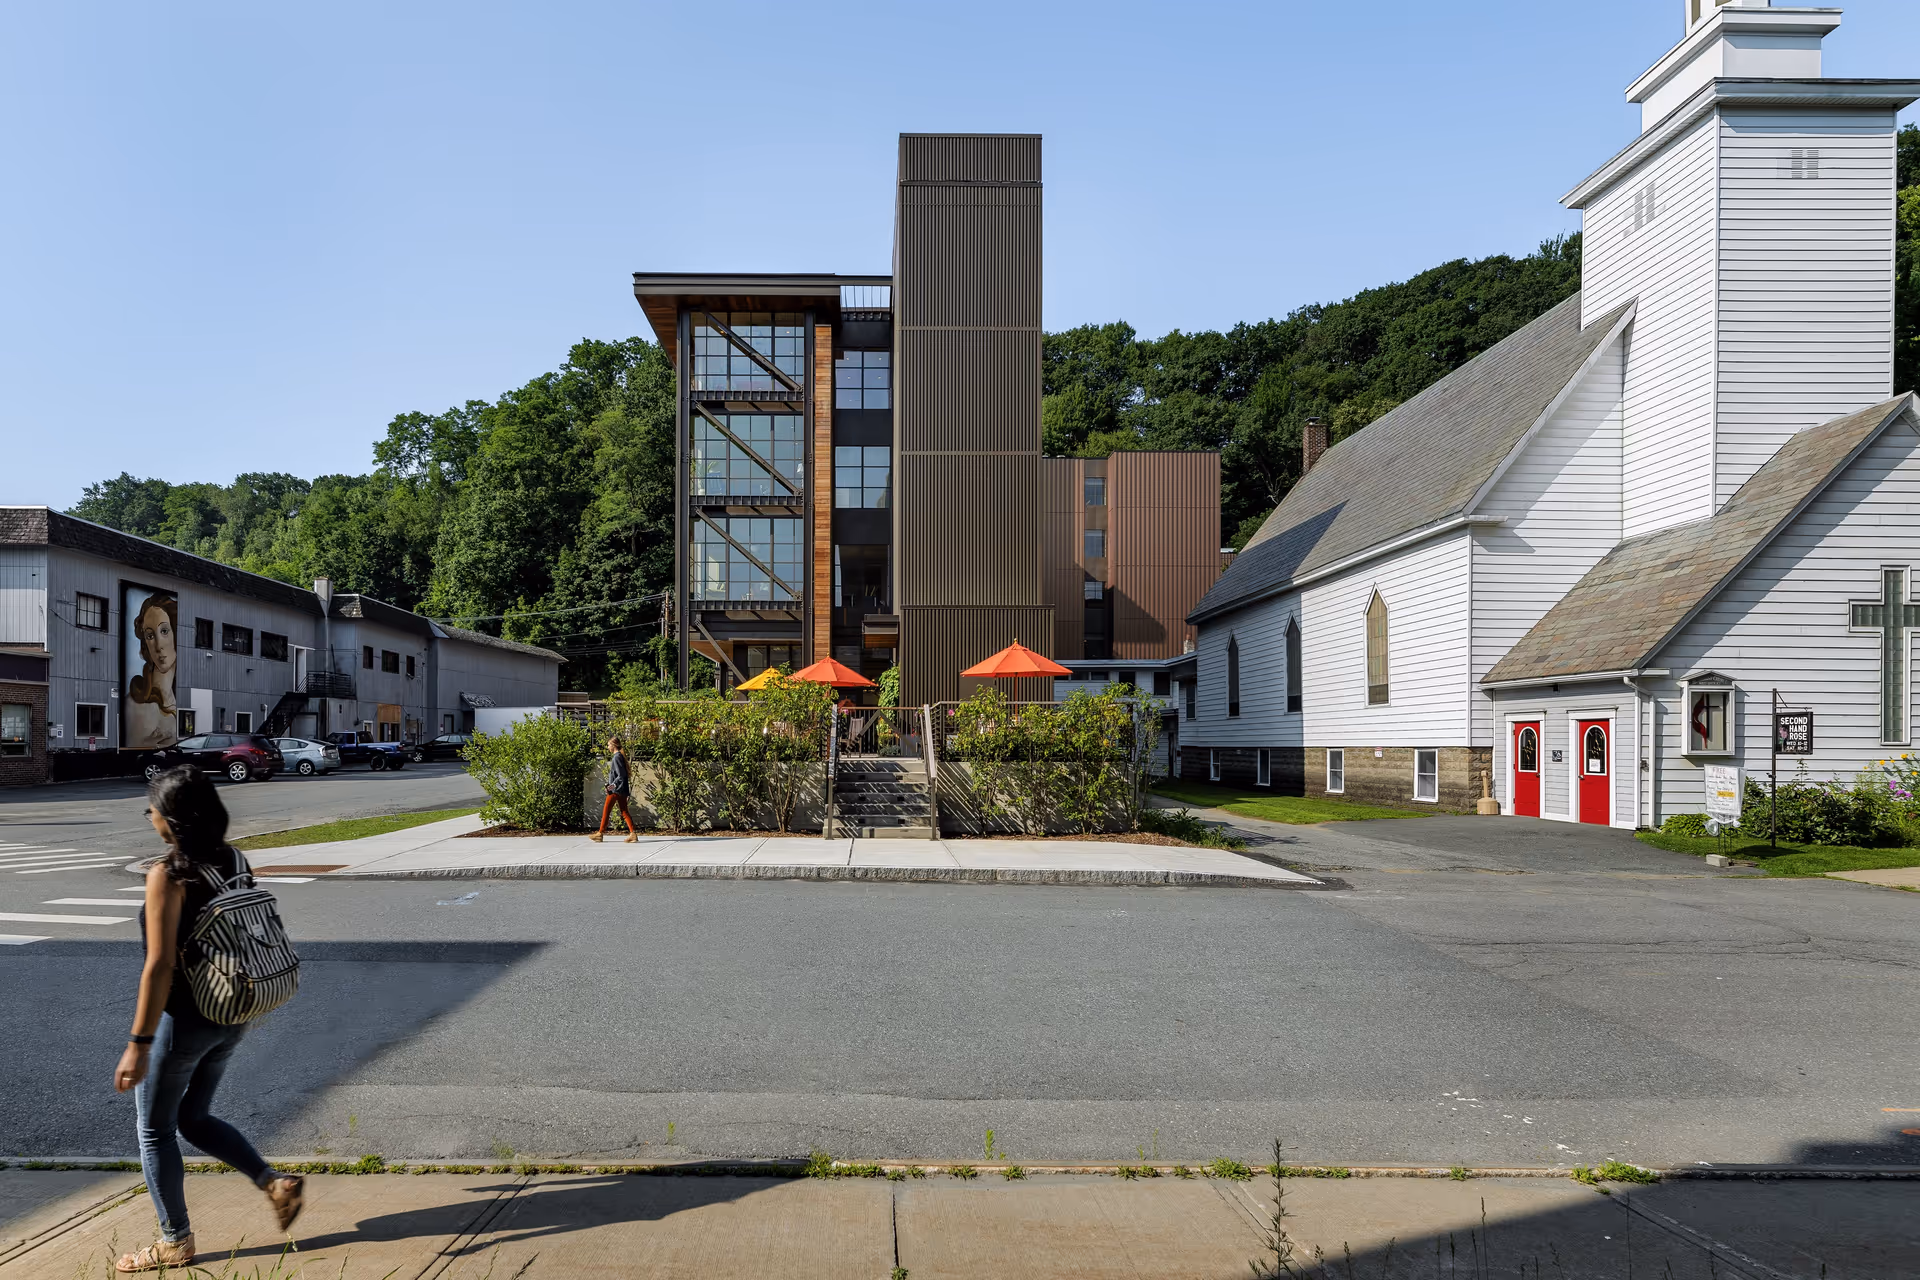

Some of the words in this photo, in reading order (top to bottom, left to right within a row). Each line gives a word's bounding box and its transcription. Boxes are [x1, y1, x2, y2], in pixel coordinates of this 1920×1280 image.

[1780, 716, 1808, 725] SECOND
[1789, 725, 1808, 733] HAND
[1789, 733, 1808, 741] ROSE
